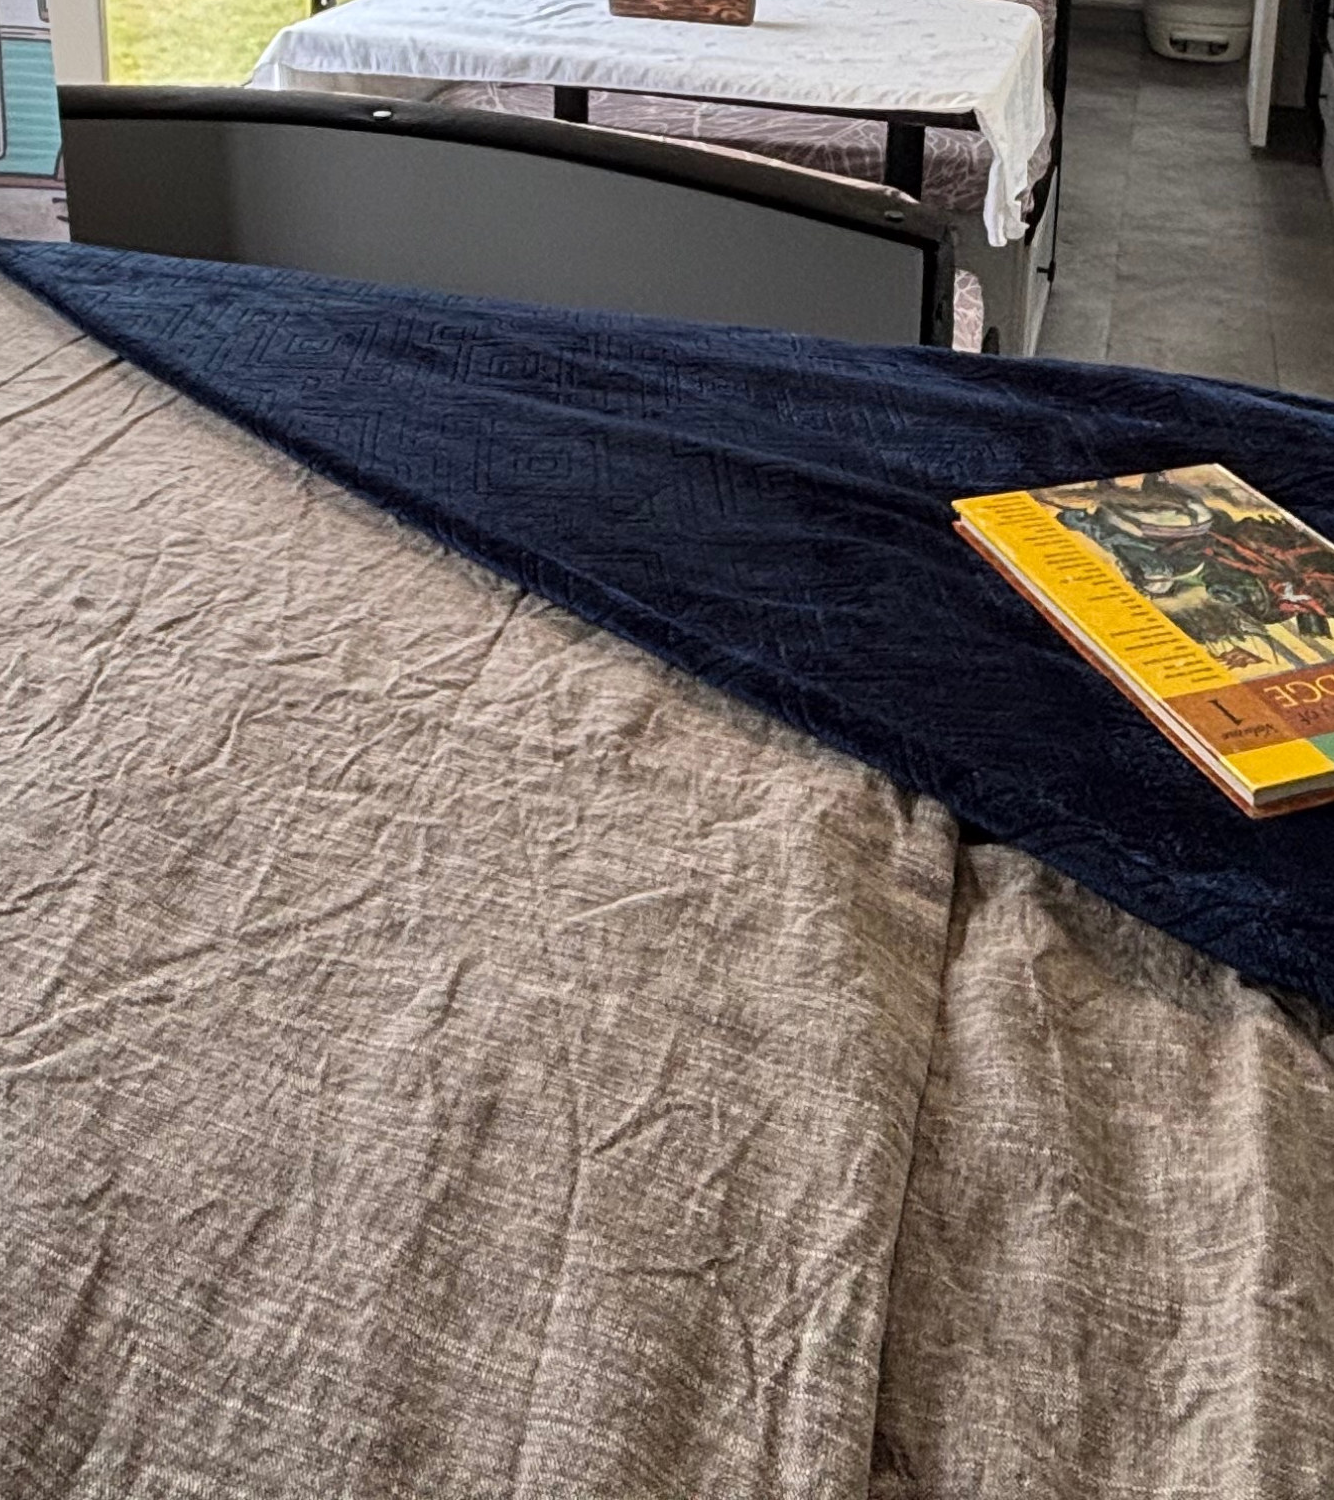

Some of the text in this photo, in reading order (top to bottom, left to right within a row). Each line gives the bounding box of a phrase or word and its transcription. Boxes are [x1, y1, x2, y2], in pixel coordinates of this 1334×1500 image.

[1208, 699, 1244, 725] 1
[1297, 710, 1321, 725] of
[1220, 722, 1279, 741] Volume
